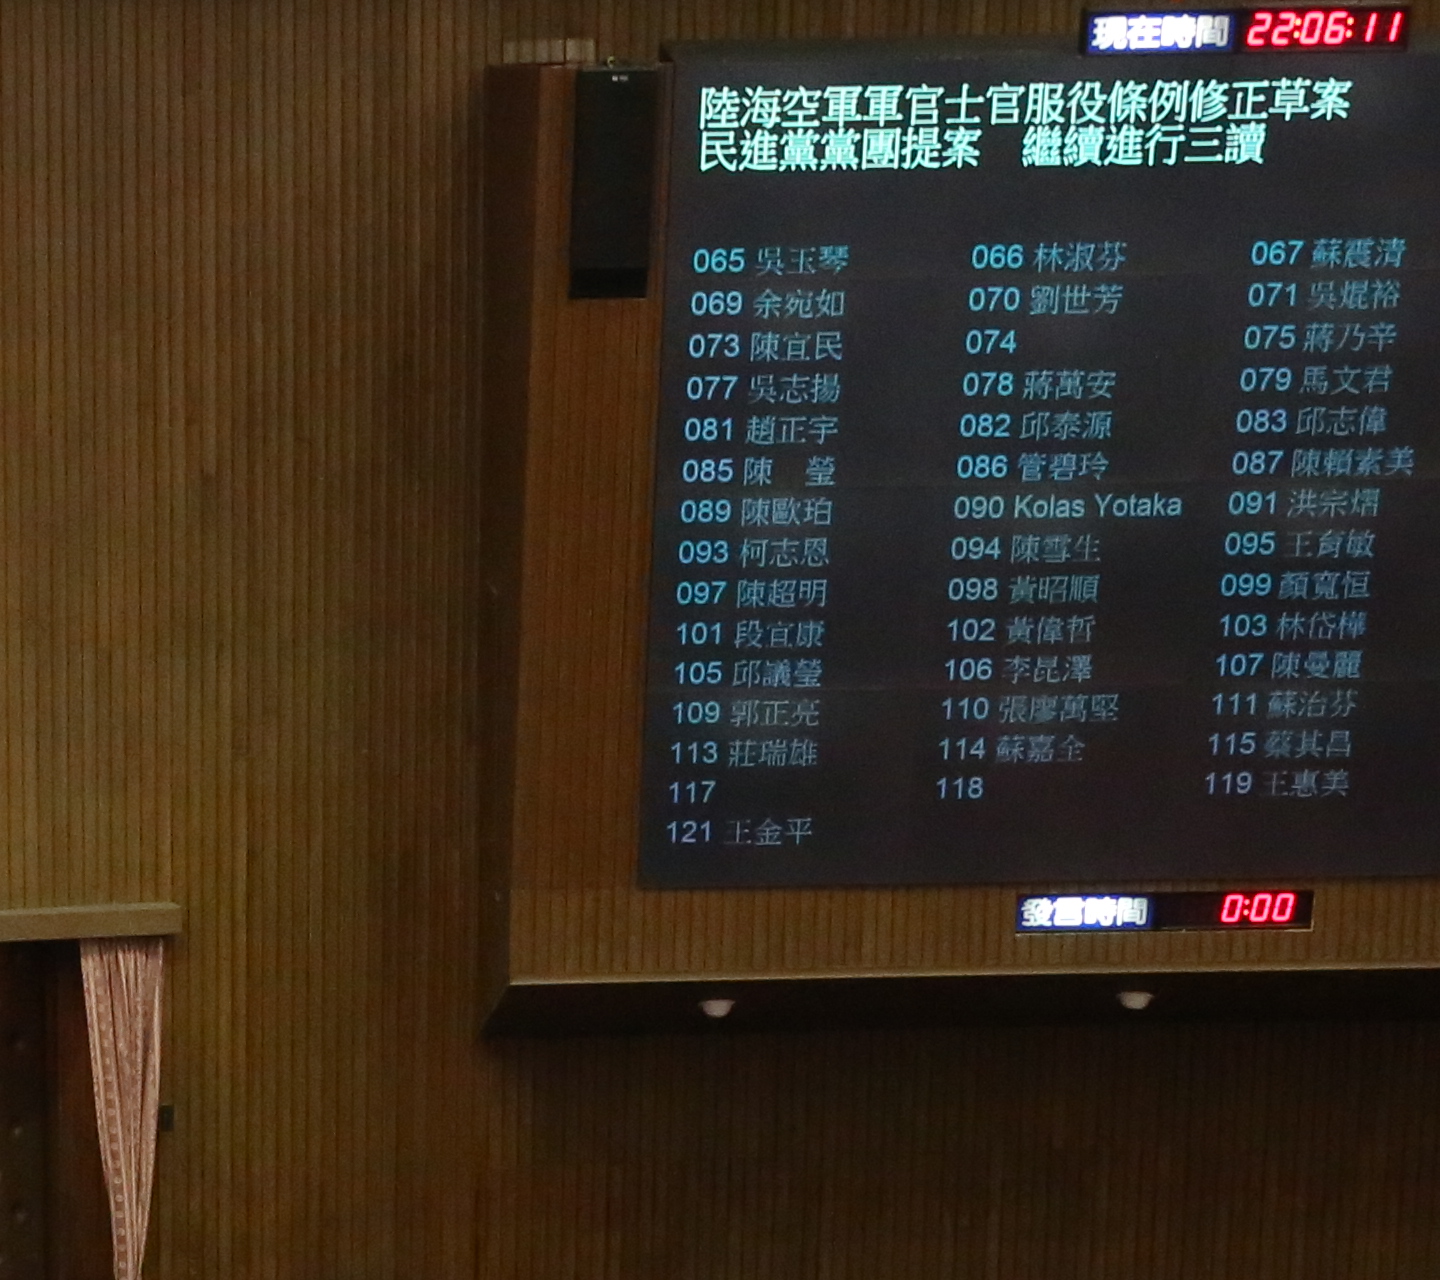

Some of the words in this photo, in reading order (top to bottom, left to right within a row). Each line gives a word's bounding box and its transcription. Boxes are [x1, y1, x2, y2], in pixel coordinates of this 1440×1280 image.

[1091, 14, 1230, 52] 現在時間
[1246, 11, 1403, 48] 22:06:11
[698, 77, 1352, 130] 陸海空軍軍官士官服役條例修正草案
[698, 126, 982, 172] 民進黨黨團提案
[1021, 123, 1266, 168] 繼續進行三讀
[692, 246, 746, 274] 065
[756, 244, 850, 276] 吳玉琴
[970, 242, 1025, 270] 066
[1033, 240, 1128, 273] 林淑芬
[1249, 238, 1306, 267] 067
[1311, 236, 1408, 269] 蘇震清
[689, 290, 744, 317] 069
[753, 288, 846, 320] 余宛如
[967, 285, 1022, 313] 070
[1029, 283, 1124, 316] 劉世芳
[1247, 281, 1297, 308] 071
[687, 332, 741, 360] 073
[749, 330, 843, 362] 陳宜民
[964, 328, 1018, 355] 074
[1243, 323, 1297, 351] 075
[1303, 321, 1398, 353] 蔣乃辛
[685, 374, 740, 401] 077
[750, 372, 842, 404] 吳志揚
[961, 370, 1015, 398] 078
[1022, 368, 1117, 400] 蔣萬安
[1239, 366, 1293, 393] 079
[1299, 364, 1394, 395] 馬文君
[683, 416, 734, 443] 081
[745, 414, 839, 446] 趙正宇
[958, 412, 1012, 439] 082
[1019, 410, 1113, 440] 邱泰源
[1235, 407, 1288, 434] 083
[1295, 405, 1388, 436] 邱志偉
[681, 457, 735, 484] 085
[956, 453, 1009, 480] 086
[1017, 451, 1110, 482] 管碧玲
[1231, 449, 1285, 476] 087
[679, 498, 733, 524] 089
[952, 494, 1006, 520] 090
[1012, 492, 1087, 520] Kolas
[1094, 491, 1184, 518] Yotaka
[1227, 490, 1277, 516] 091
[677, 539, 730, 565] 093
[740, 536, 830, 568] 柯志恩
[950, 535, 1002, 561] 094
[1223, 530, 1276, 557] 095
[675, 580, 728, 606] 097
[736, 578, 828, 608] 陳超明
[947, 576, 999, 602] 098
[1219, 572, 1273, 598] 099
[676, 621, 722, 646] 101
[946, 617, 997, 642] 102
[1219, 613, 1268, 638] 103
[673, 660, 723, 686] 105
[944, 657, 993, 682] 106
[1215, 652, 1265, 677] 107
[672, 700, 722, 725] 109
[941, 696, 990, 721] 110
[1211, 692, 1258, 716] 111
[670, 740, 719, 765] 113
[938, 736, 987, 761] 114
[1208, 731, 1257, 756] 115
[668, 779, 717, 805] 117
[936, 775, 985, 800] 118
[1204, 770, 1254, 795] 119
[666, 819, 711, 844] 121
[724, 816, 813, 846] 王金平
[1020, 896, 1149, 928] 發言時間
[1220, 892, 1297, 924] 0:00
